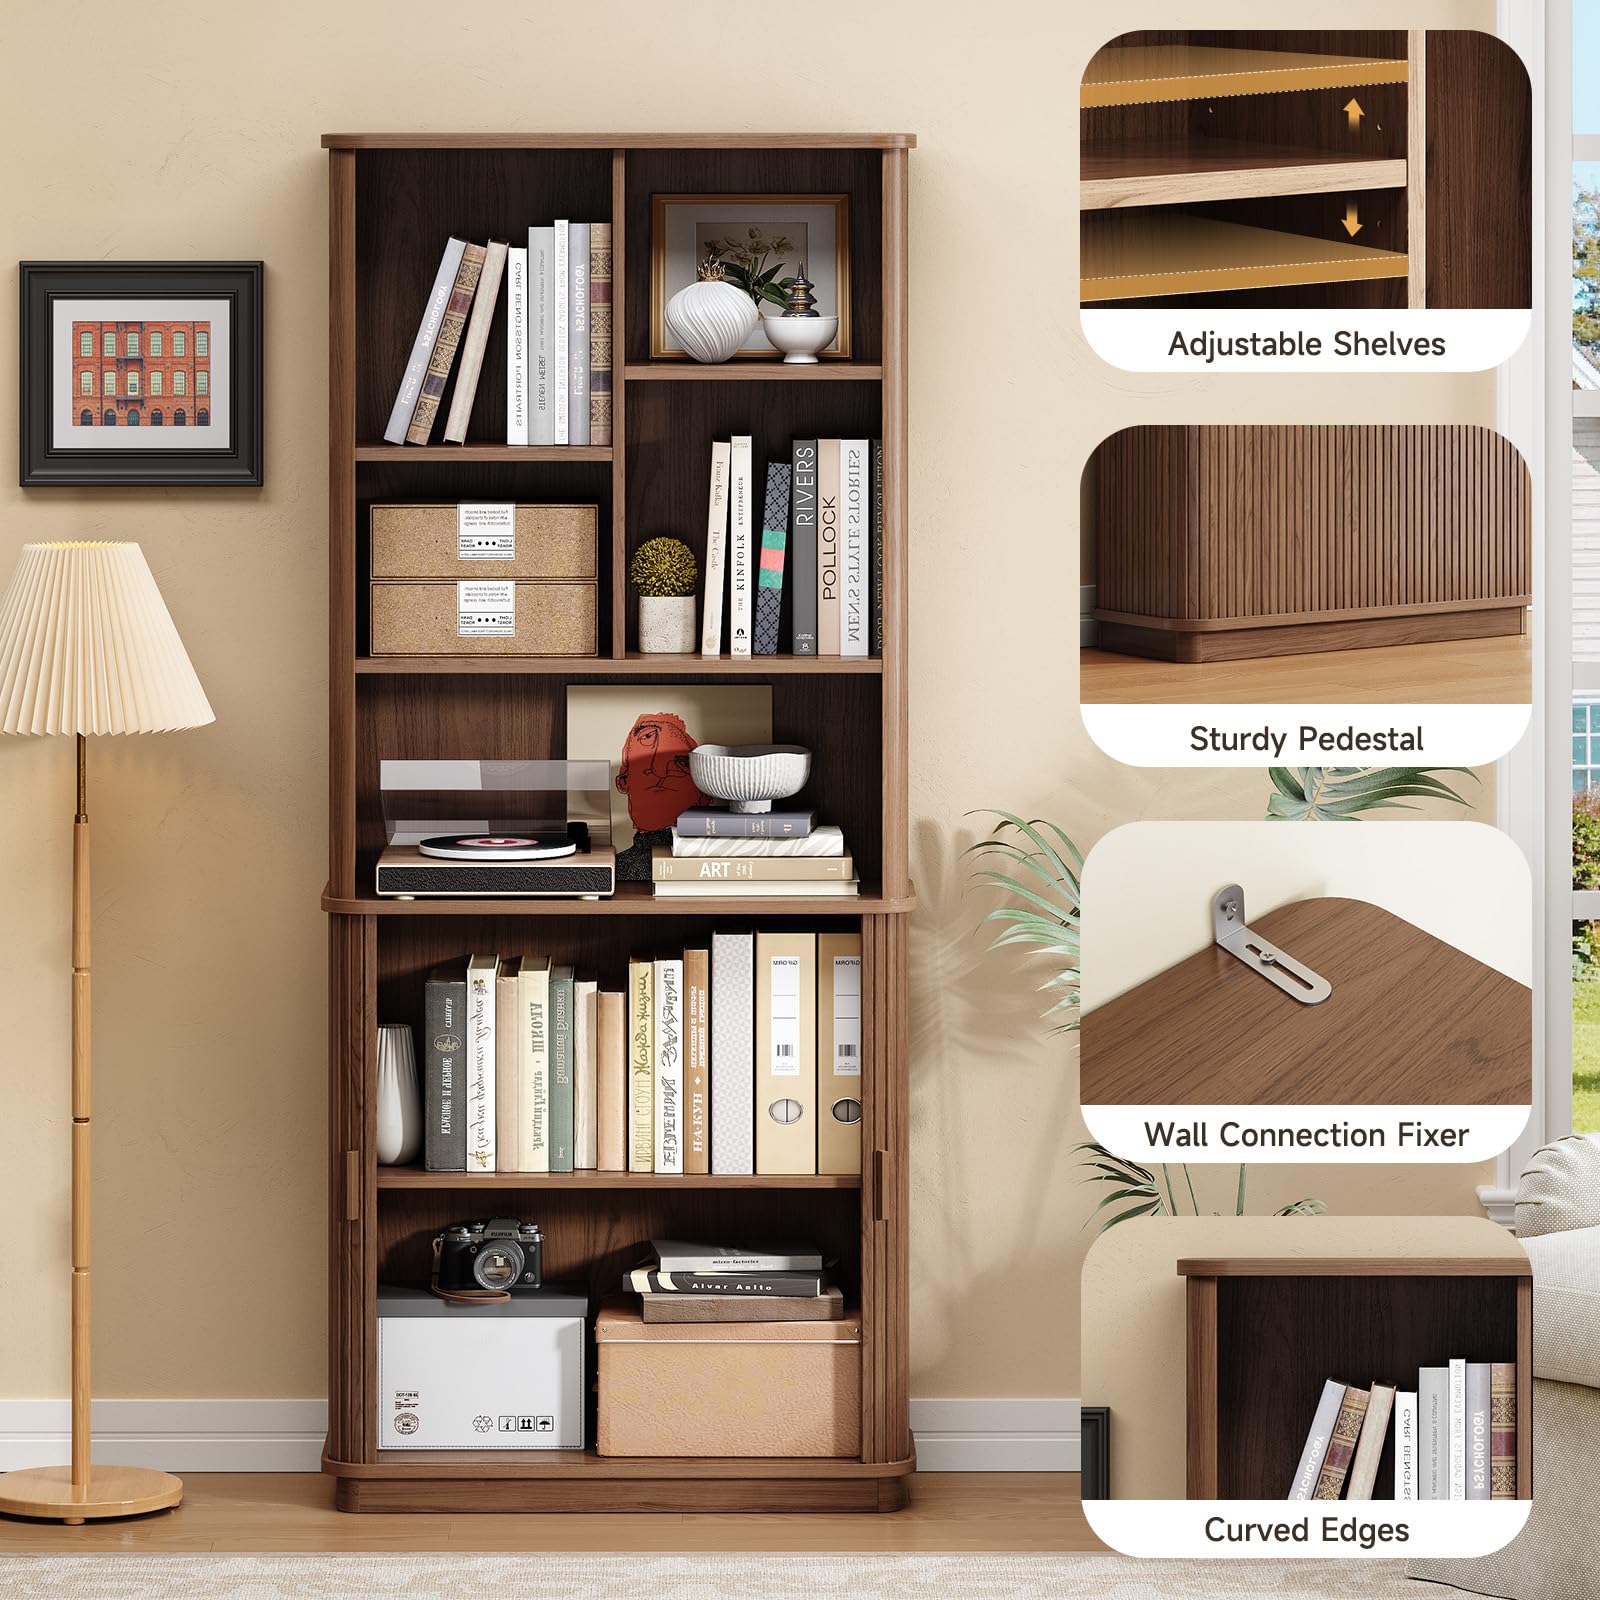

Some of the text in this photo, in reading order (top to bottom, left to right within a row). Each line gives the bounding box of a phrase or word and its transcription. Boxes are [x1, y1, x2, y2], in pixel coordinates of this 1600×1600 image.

[713, 484, 723, 507] Kafka
[796, 447, 814, 526] RIVERS
[736, 534, 745, 591] KINFOLK
[823, 495, 836, 600] POLLOCK
[699, 862, 731, 878] ART
[634, 971, 652, 1163] ИРВИНГ СТОУН Жажда жизни
